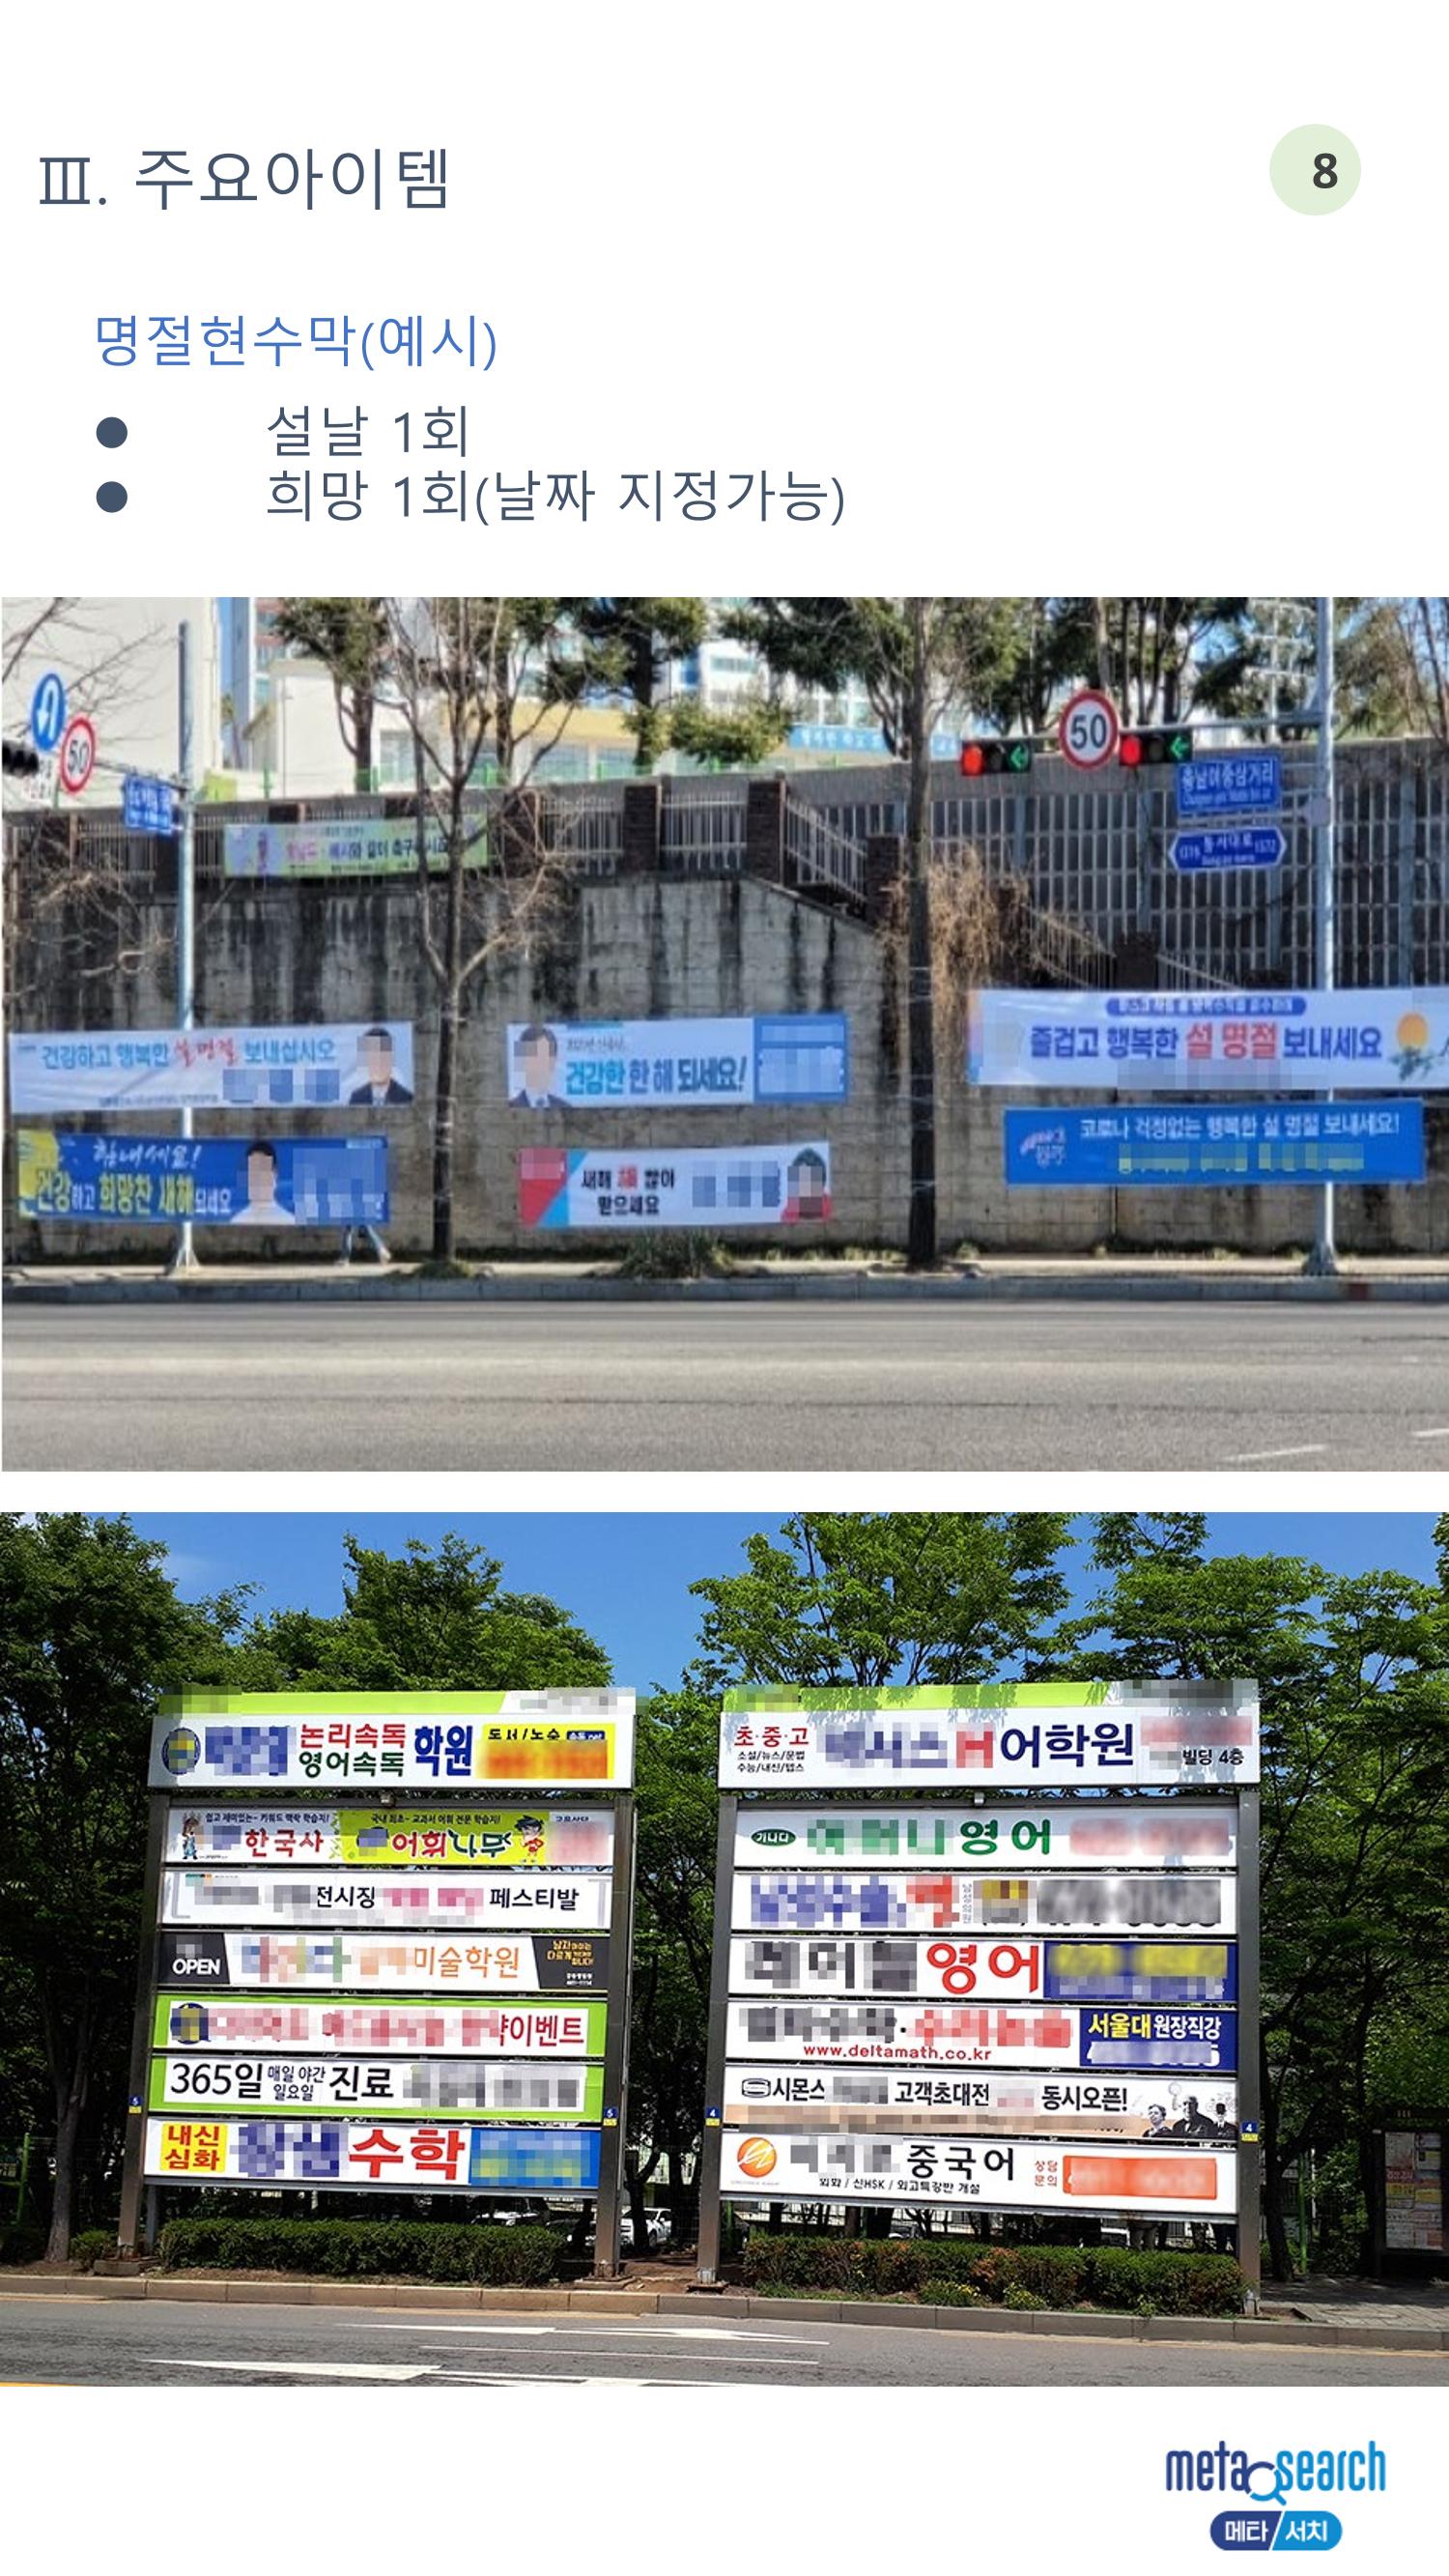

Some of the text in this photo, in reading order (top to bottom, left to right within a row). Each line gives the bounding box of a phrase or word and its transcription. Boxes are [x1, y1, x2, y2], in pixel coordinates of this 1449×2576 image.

[1070, 713, 1107, 749] 50
[68, 741, 91, 772] 50
[42, 1044, 111, 1071] 건강하고
[117, 1042, 170, 1069] 행복한
[244, 1038, 336, 1064] 보내십시오
[1030, 1021, 1382, 1060] 즐겁고 행복한 설 명절 보내세요
[565, 1056, 748, 1096] 건강한 한 해 되세요!
[1080, 1119, 1129, 1140] 코로나
[1206, 1118, 1257, 1140] 행복한
[1263, 1116, 1282, 1139] 설
[1285, 1115, 1320, 1138] 명절
[99, 1173, 154, 1215] 희망찬
[582, 1169, 612, 1190] 새해
[644, 1168, 675, 1189] 많이
[597, 1195, 661, 1216] 받으세요
[301, 1724, 406, 1749] 논리속독
[414, 1725, 473, 1777] 학원
[299, 1752, 404, 1778] 영어속독
[1181, 1748, 1244, 1766] 빌딩 4층
[244, 1826, 325, 1858] 한국사
[960, 1818, 1051, 1855] 영어
[489, 1886, 580, 1910] 페스티발
[173, 1958, 220, 1976] OPEN
[414, 1946, 520, 1979] 미술학원
[926, 1942, 1038, 1994] 영어
[1088, 2013, 1222, 2040] 서울대 원장직강
[804, 2045, 991, 2060] www.deltamath.co.kr
[170, 2063, 394, 2101] 365일 매일 야간 진료
[273, 2084, 314, 2102] 일요일
[773, 2077, 1127, 2111] 시몬스 고객초대전 동시오픈!
[168, 2125, 220, 2147] 내신
[164, 2149, 220, 2171] 심화
[349, 2128, 466, 2181] 수학
[907, 2144, 1014, 2181] 중국어
